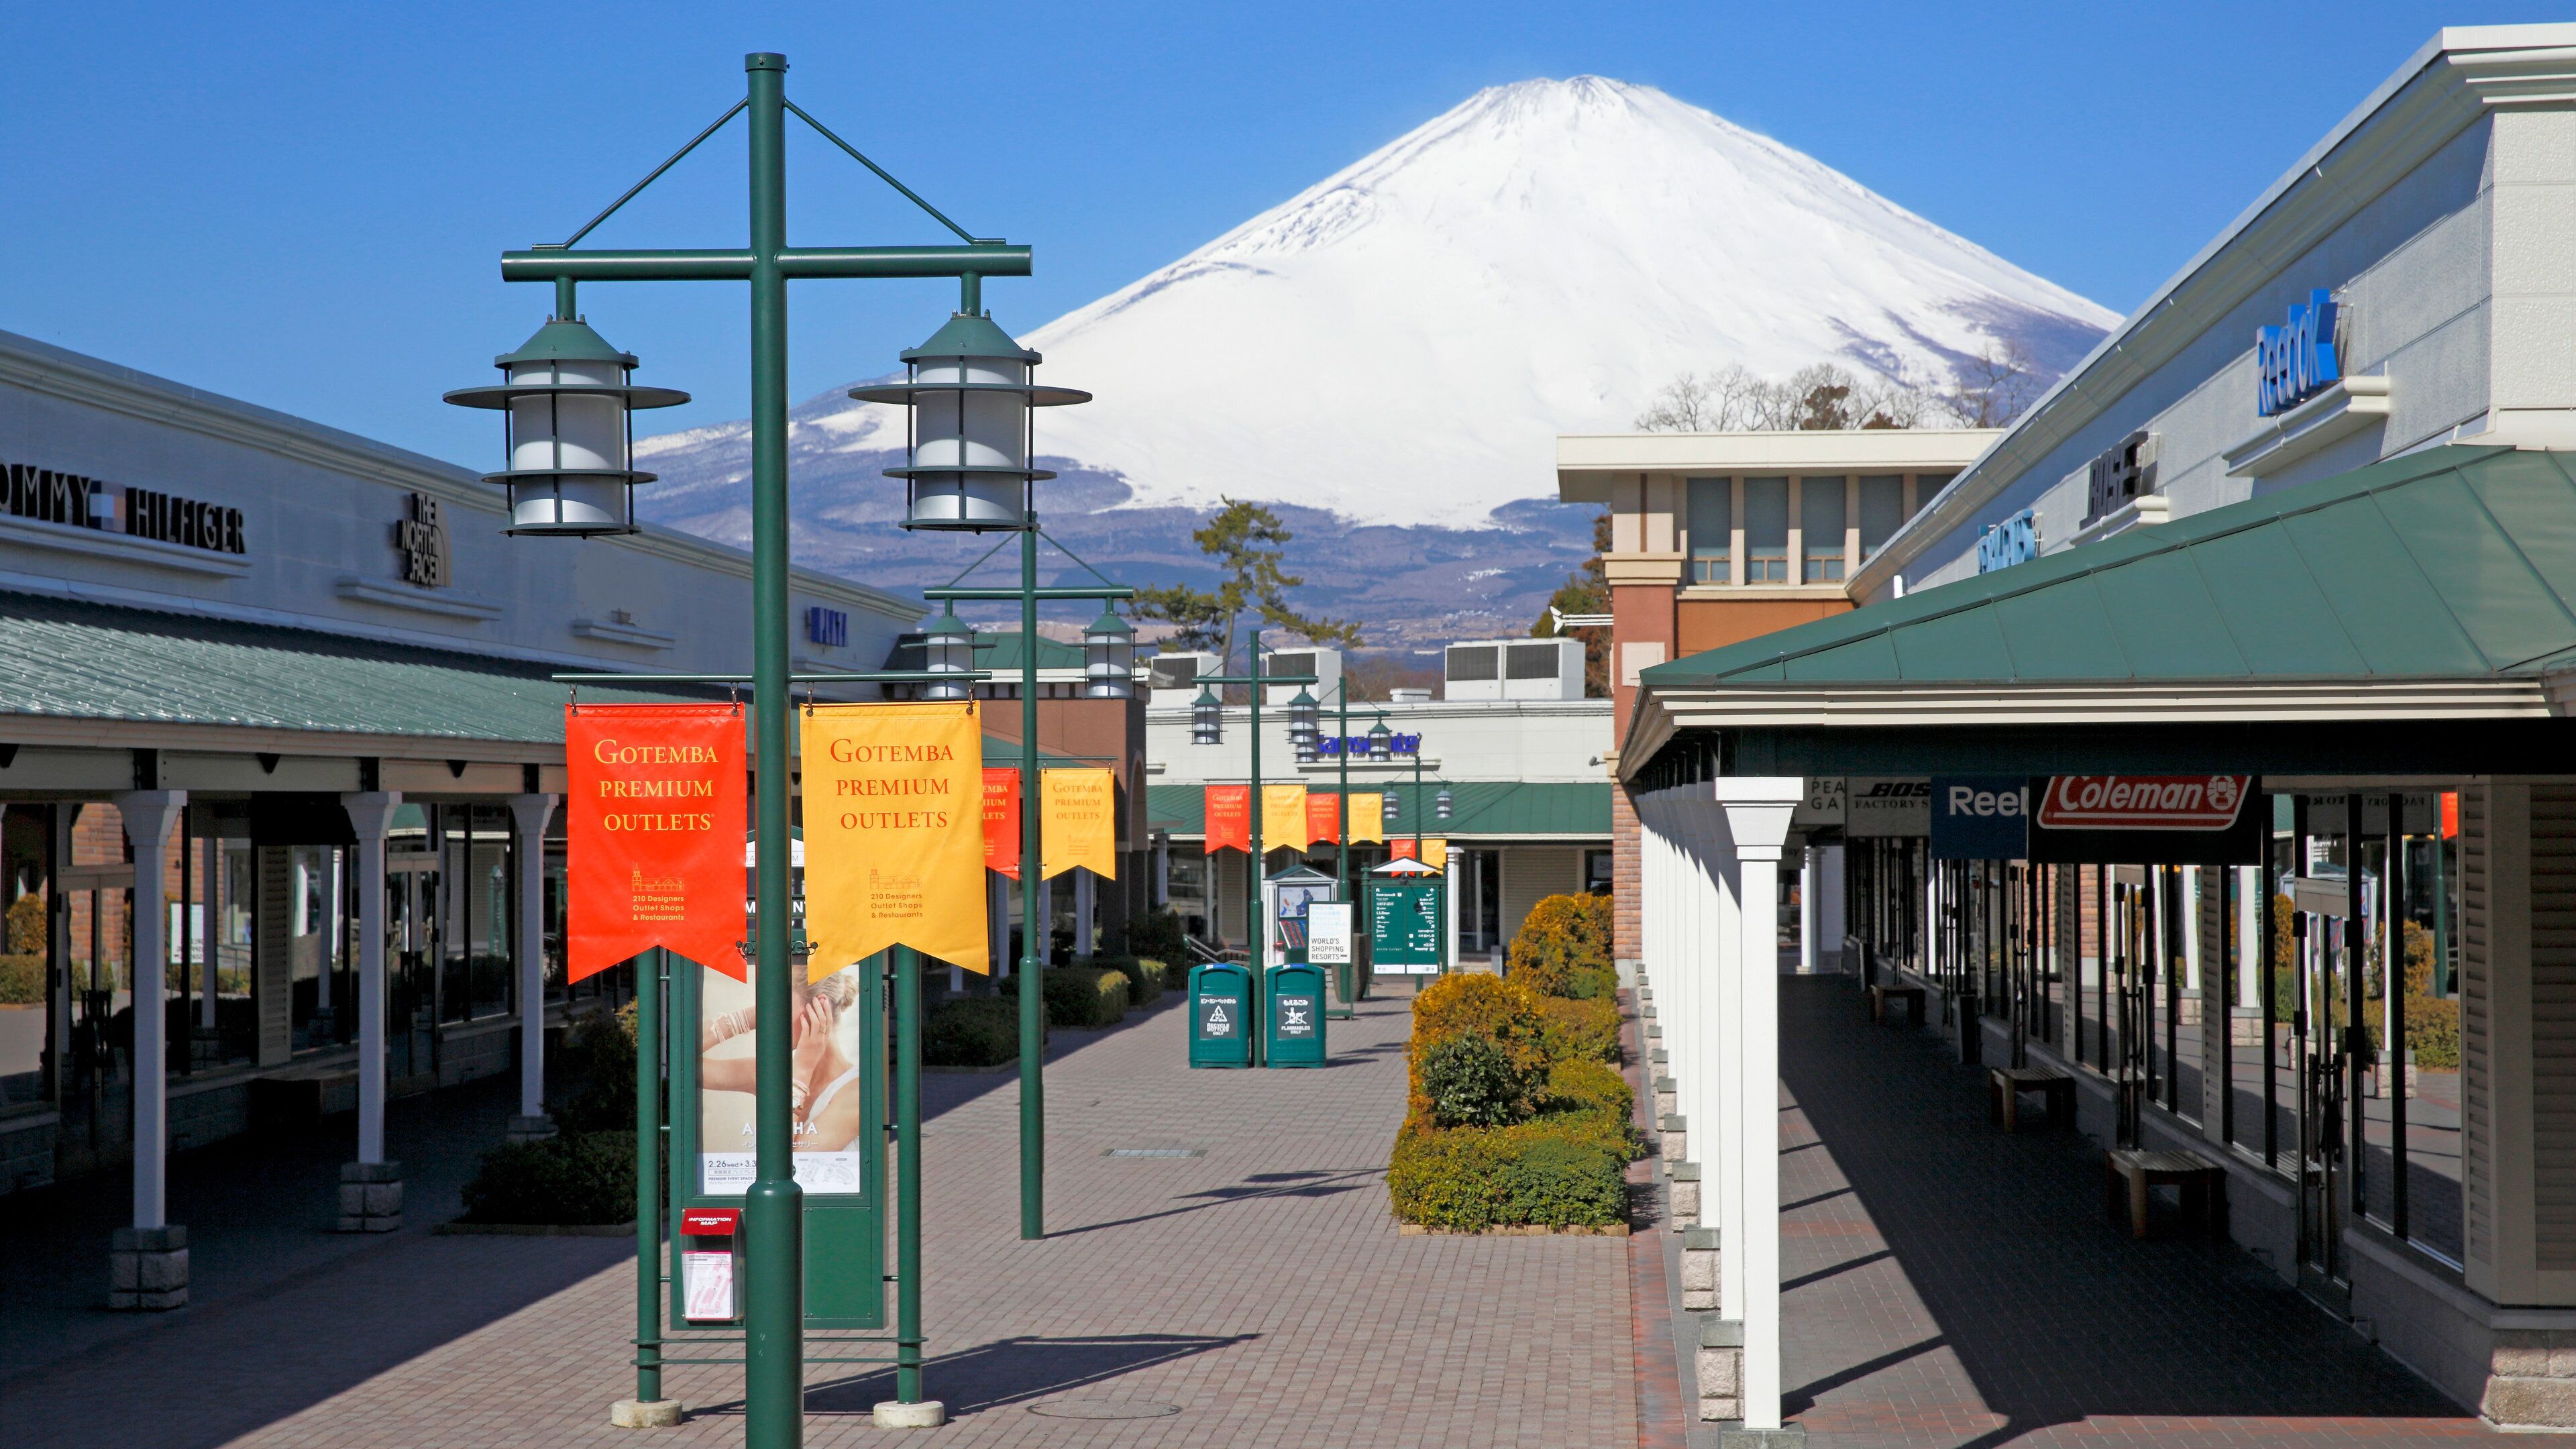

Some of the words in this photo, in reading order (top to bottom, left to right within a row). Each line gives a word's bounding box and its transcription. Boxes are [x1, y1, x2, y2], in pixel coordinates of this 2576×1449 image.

[411, 493, 436, 525] THE
[127, 487, 246, 553] HILFIGER
[396, 520, 437, 557] NORTH
[407, 551, 437, 585] FACE
[594, 739, 718, 763] GOTEMBA
[830, 739, 954, 763] GOTEMBA
[600, 780, 713, 798] PREMIUM
[837, 778, 949, 796] PREMIUM
[1053, 782, 1102, 793] GOTEMBA
[2059, 776, 2202, 810] Coleman
[1055, 798, 1101, 806] PREMIUM
[1950, 786, 2027, 816] Ree
[604, 813, 711, 831] OUTLETS
[841, 812, 947, 829] OUTLETS
[1057, 812, 1100, 820] OUTLETS
[647, 895, 684, 904] Designers
[885, 894, 922, 902] Designers
[899, 902, 922, 910] Shops
[660, 904, 684, 912] Shops
